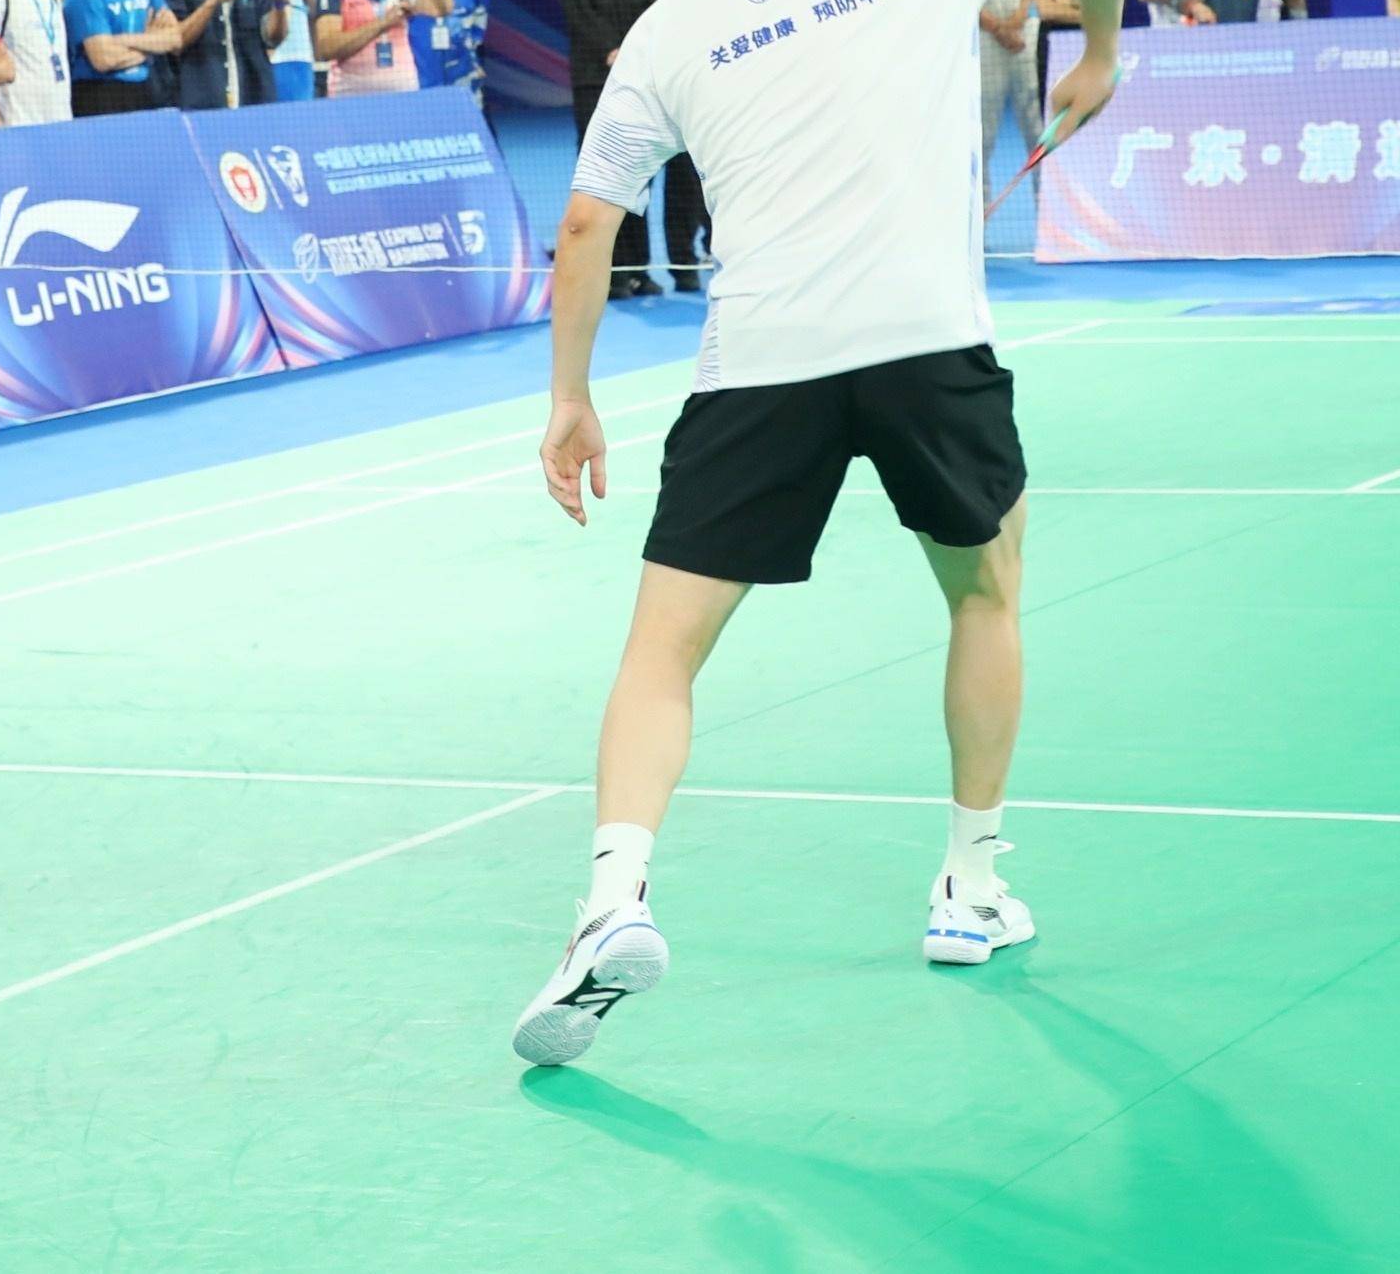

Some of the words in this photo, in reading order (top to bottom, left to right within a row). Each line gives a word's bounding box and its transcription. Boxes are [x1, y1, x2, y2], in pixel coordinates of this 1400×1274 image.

[710, 17, 798, 70] 关爱健康
[5, 262, 171, 327] LI-NING
